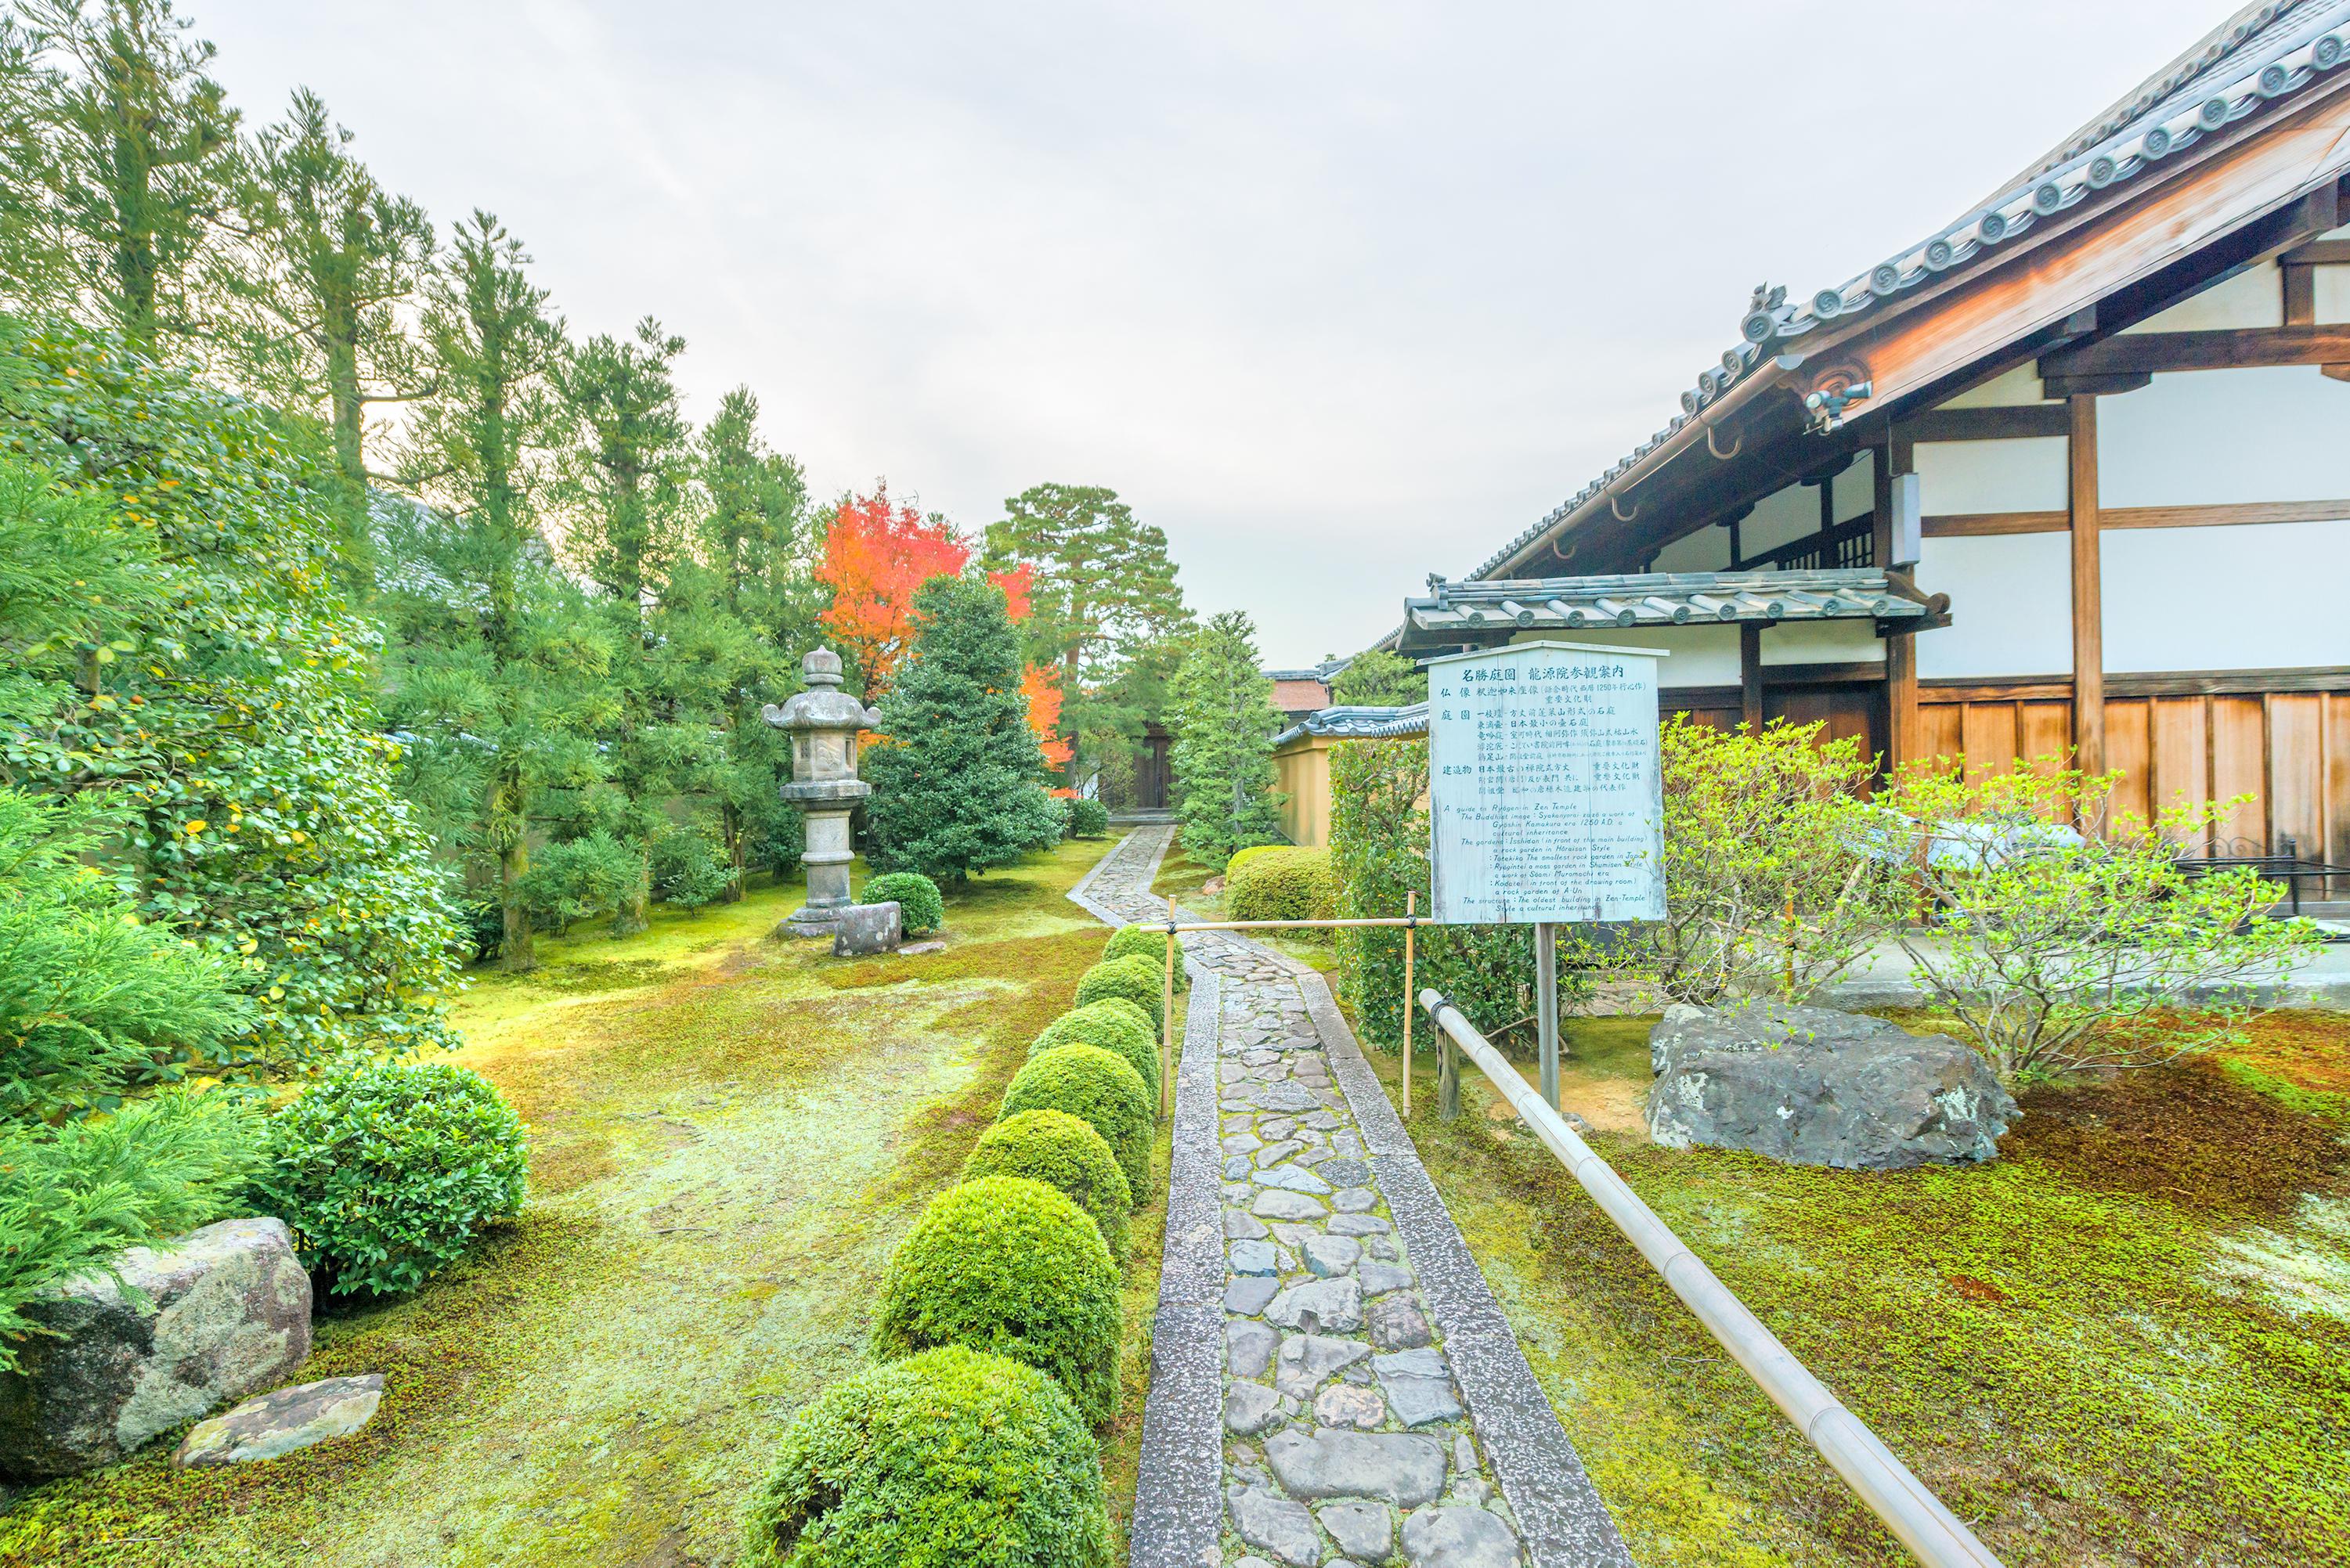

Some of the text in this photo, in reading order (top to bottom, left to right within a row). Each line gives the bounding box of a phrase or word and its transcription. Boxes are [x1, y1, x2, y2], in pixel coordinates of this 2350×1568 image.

[1463, 665, 1623, 682] 名勝庭園 龍源院参観案内
[1442, 765, 1472, 776] 建造物
[1591, 844, 1611, 852] Style
[1590, 852, 1615, 861] garden
[1585, 878, 1613, 886] drawing
